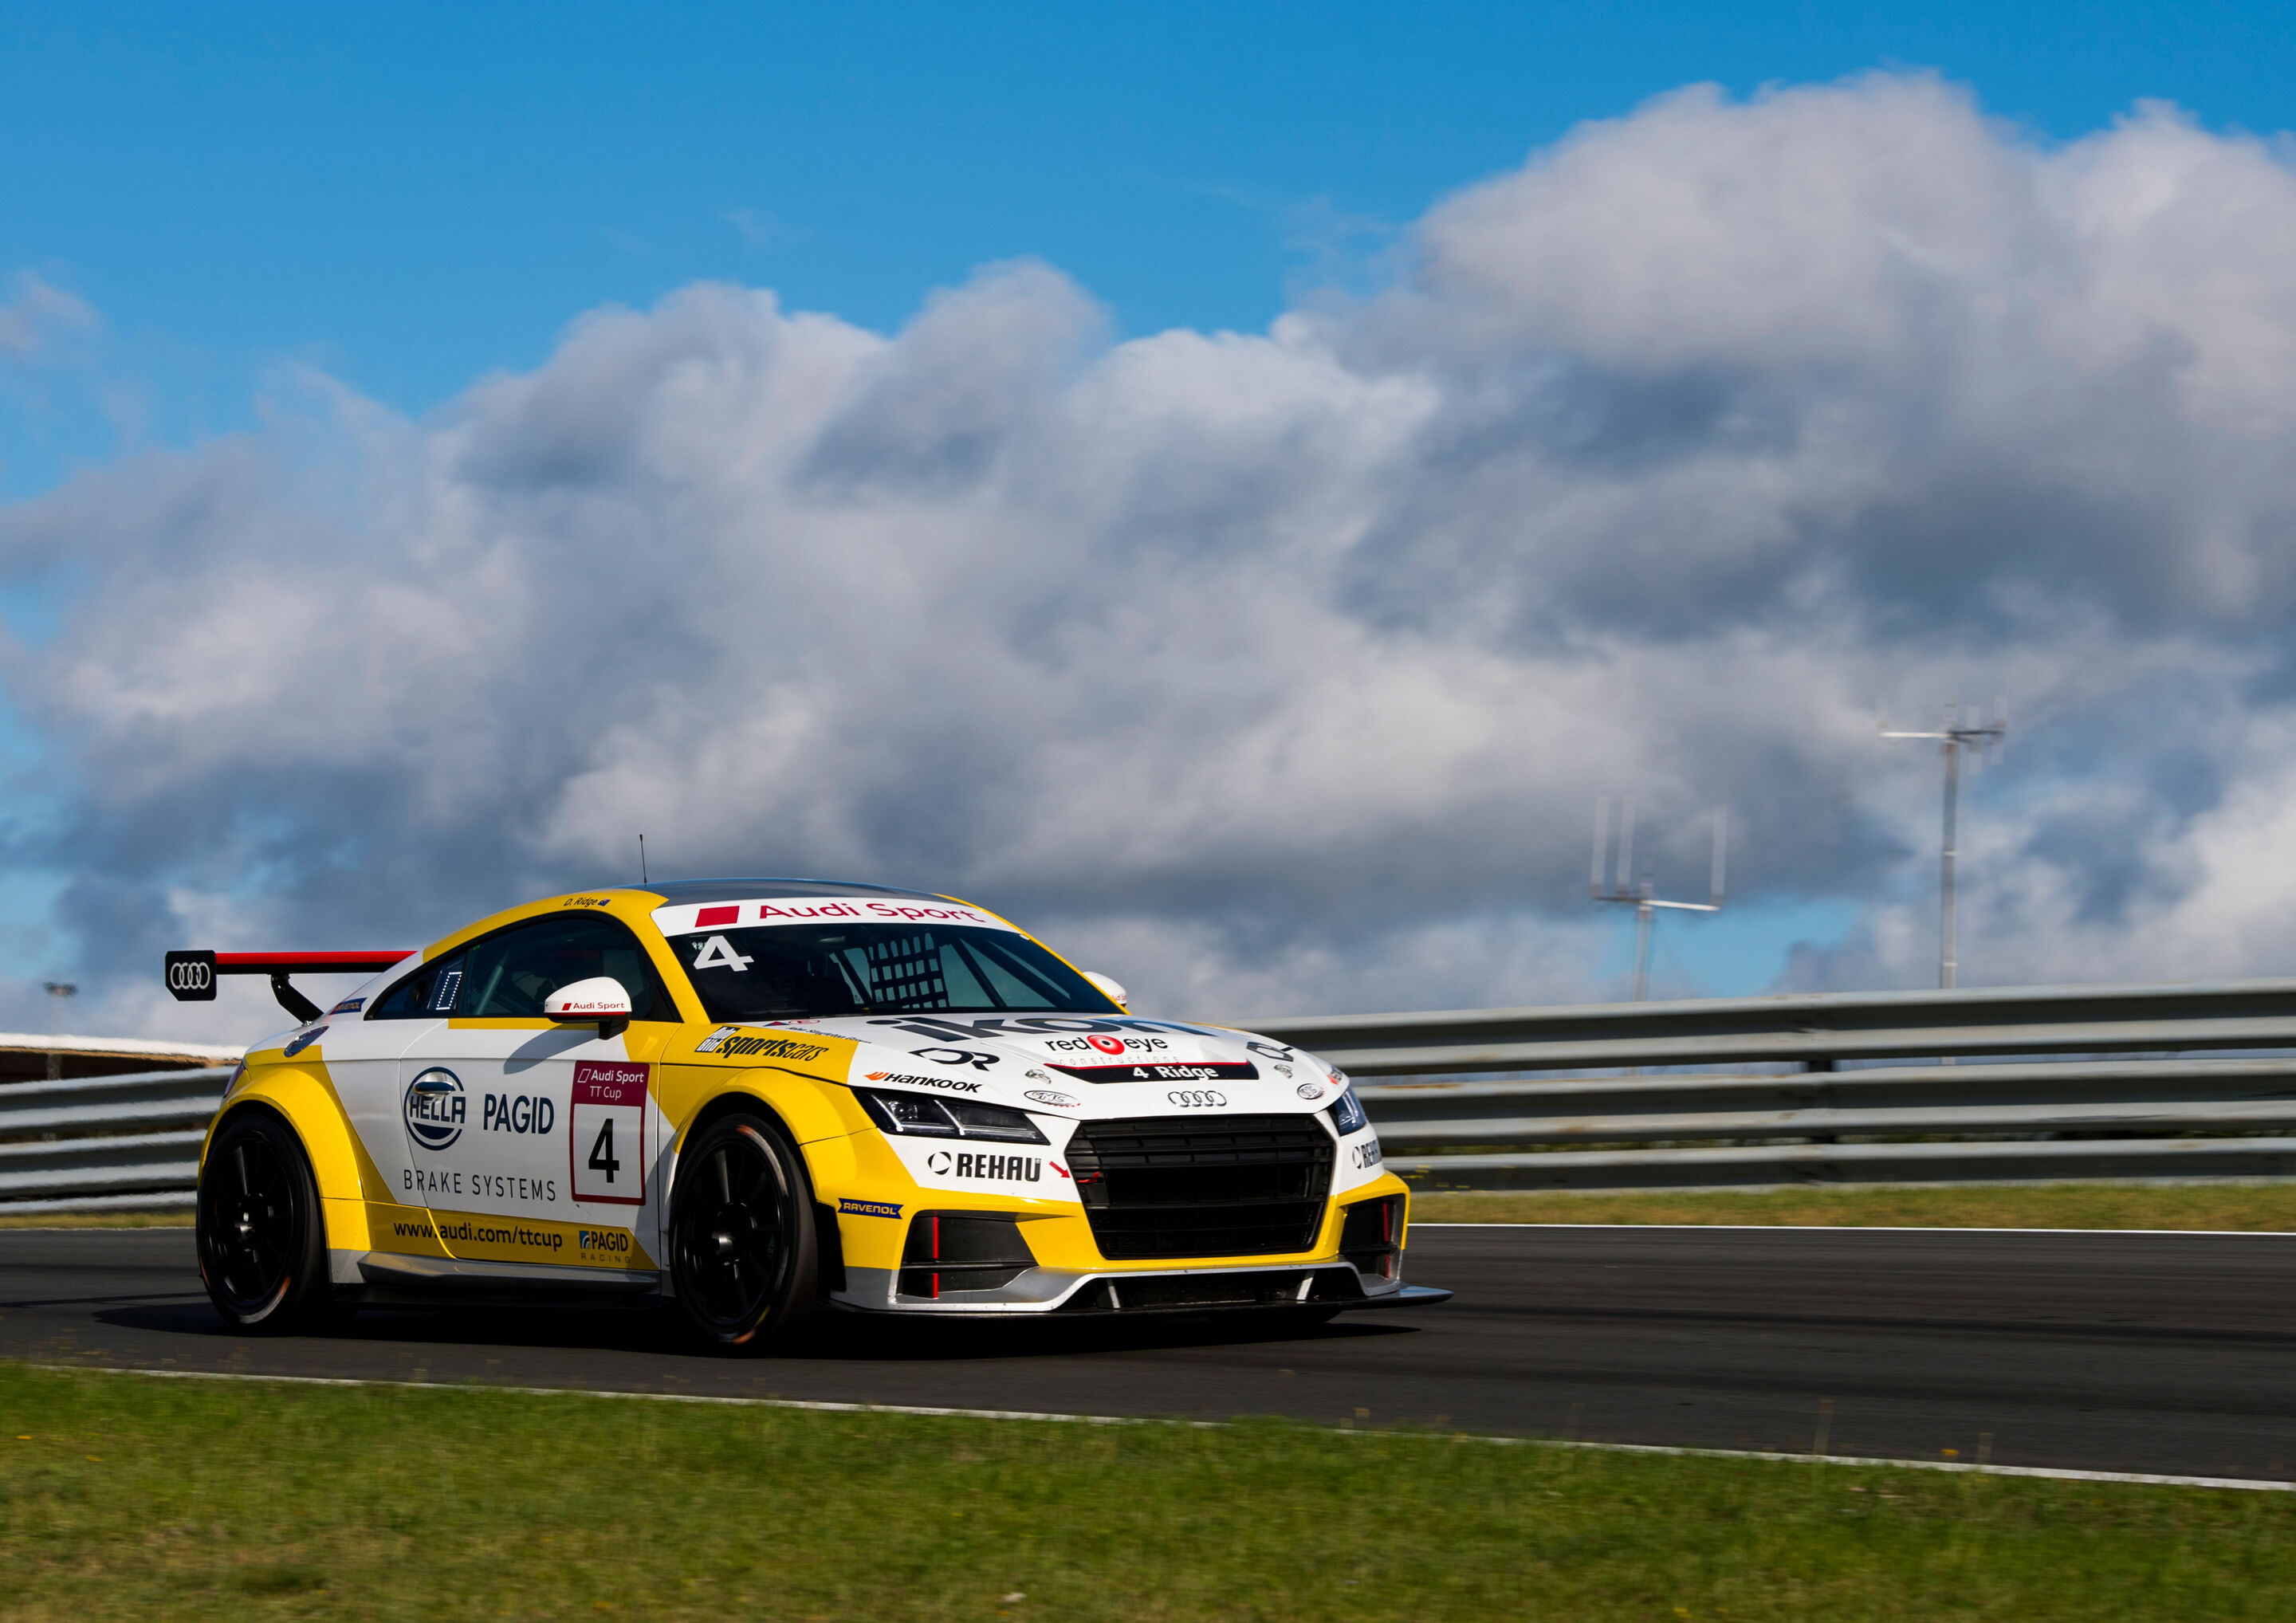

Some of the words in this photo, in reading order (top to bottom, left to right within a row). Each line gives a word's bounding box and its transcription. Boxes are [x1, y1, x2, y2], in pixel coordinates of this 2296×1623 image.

[574, 898, 599, 907] Ridge
[759, 903, 861, 920] Audi
[867, 902, 986, 923] Sport
[693, 935, 755, 973] 4
[598, 1002, 625, 1011] Sport
[1045, 1037, 1093, 1052] red
[1122, 1037, 1169, 1052] eye
[1059, 1055, 1181, 1067] constructions
[591, 1069, 615, 1083] Audi
[616, 1071, 645, 1085] Sport
[1133, 1067, 1150, 1079] 4
[1154, 1065, 1219, 1081] Ridge
[590, 1086, 603, 1097] TT
[603, 1087, 622, 1101] Cup
[410, 1095, 466, 1124] HELLA
[483, 1094, 555, 1135] PAGID
[588, 1118, 620, 1184] 4
[957, 1153, 1041, 1182] REHAU
[403, 1169, 462, 1194] BRAKE
[472, 1174, 556, 1201] SYSTEMS
[843, 1202, 897, 1216] RAVENOL
[394, 1221, 563, 1252] www.audi.com/ttcup
[591, 1231, 629, 1252] PAGID
[580, 1252, 631, 1263] RACING
